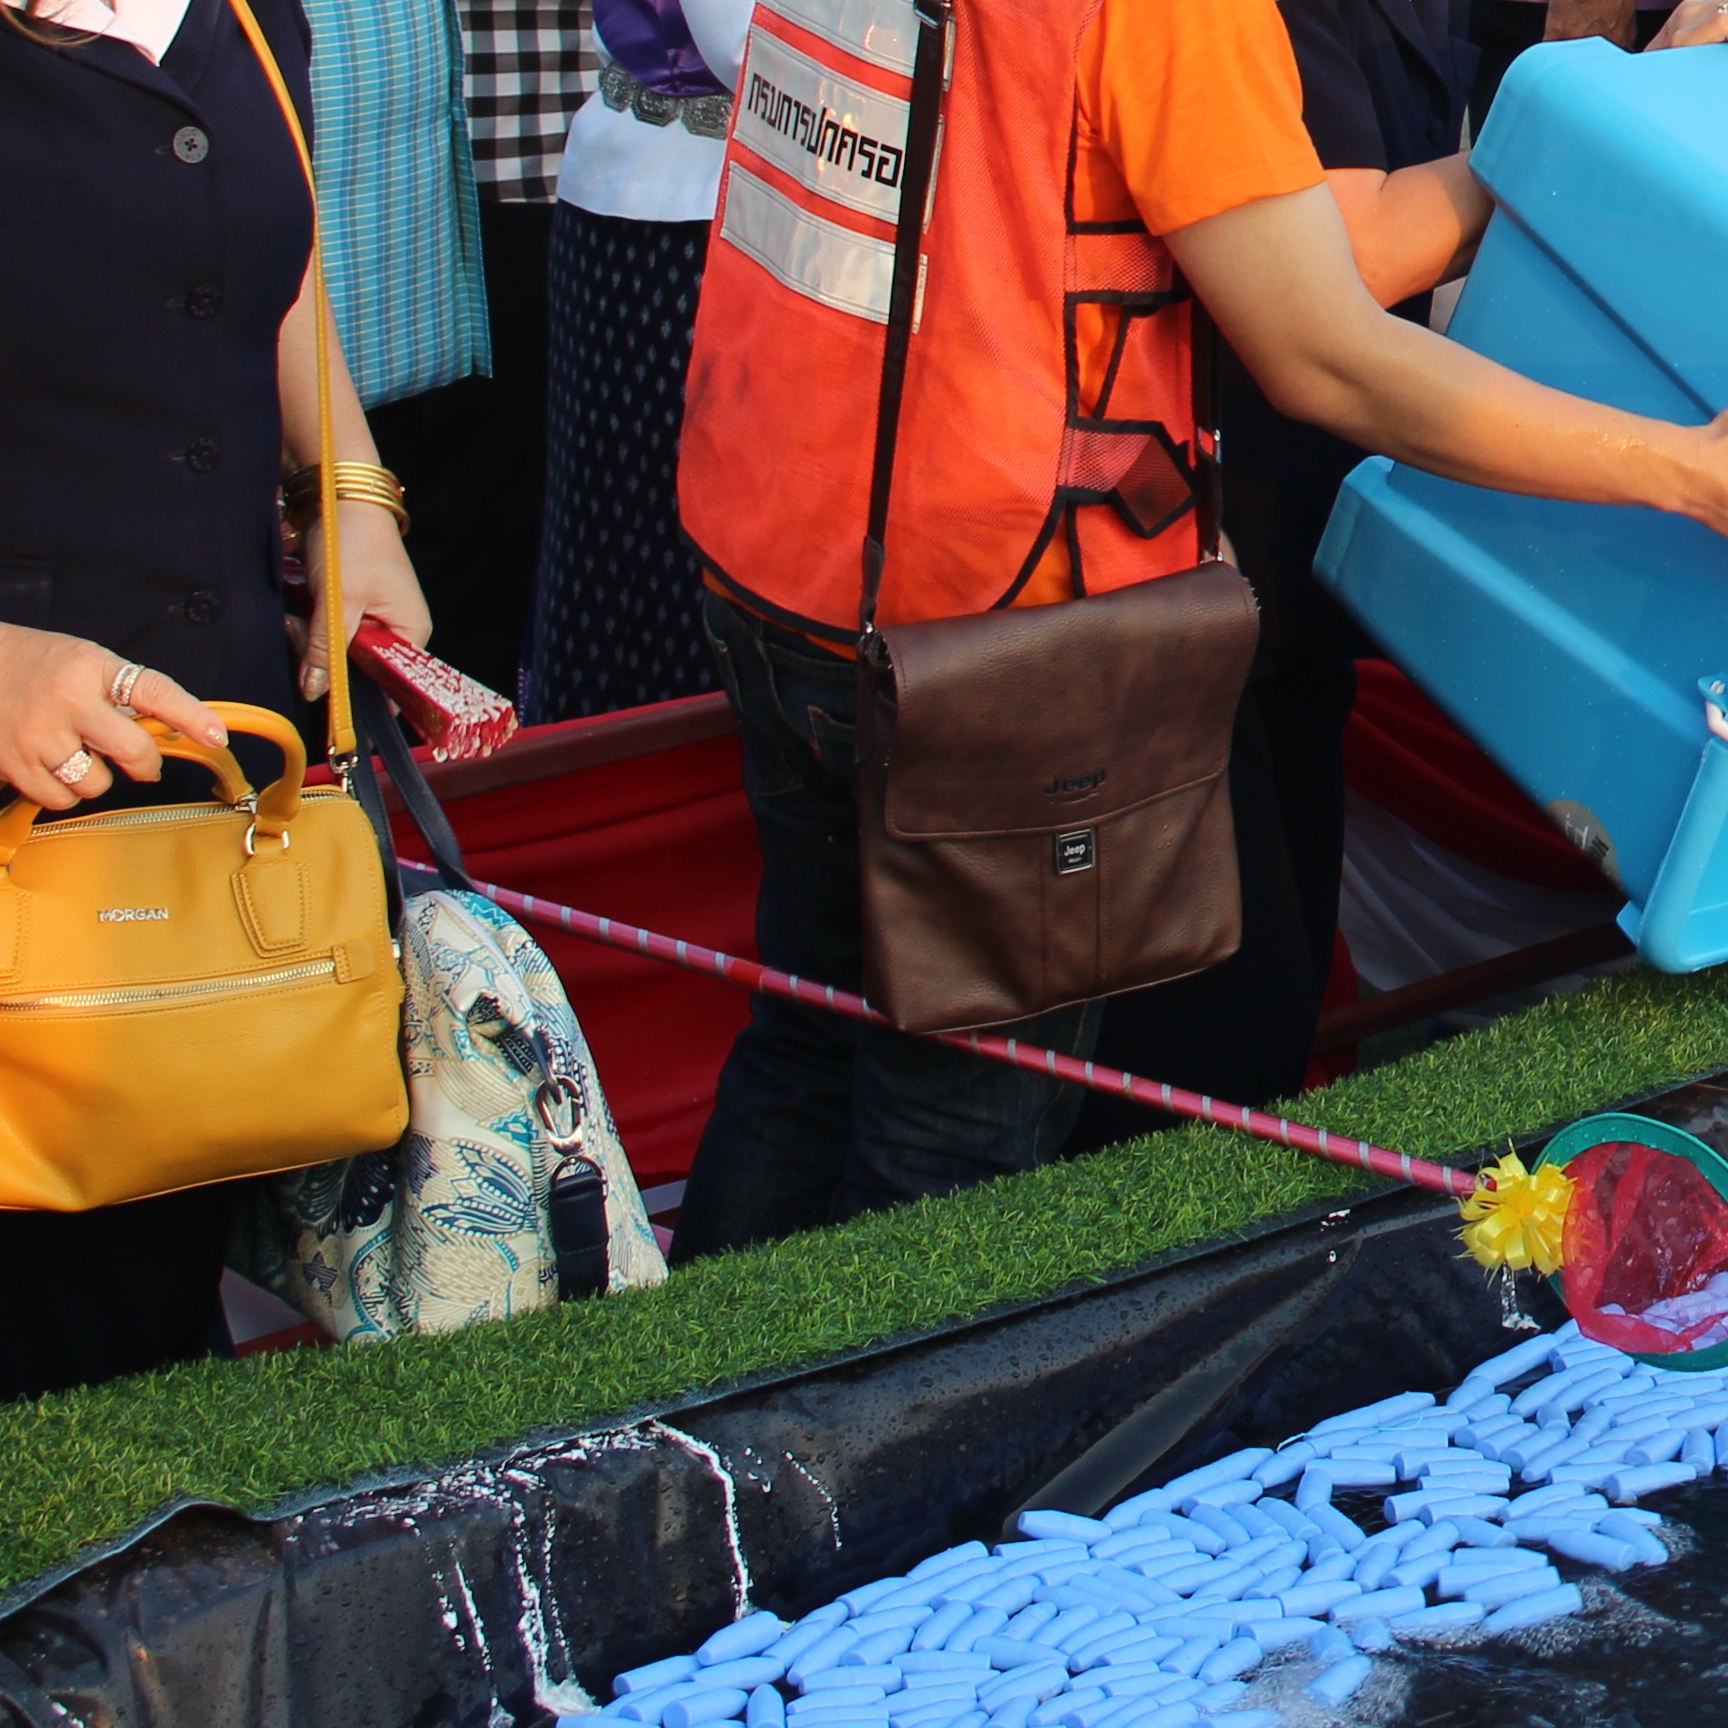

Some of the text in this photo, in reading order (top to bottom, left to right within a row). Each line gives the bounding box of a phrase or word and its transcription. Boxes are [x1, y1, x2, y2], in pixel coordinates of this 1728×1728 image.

[748, 72, 903, 189] กรมการปกครอ
[1043, 769, 1106, 794] Jeep
[1063, 843, 1086, 857] Jeep
[97, 907, 170, 923] MORGAN
